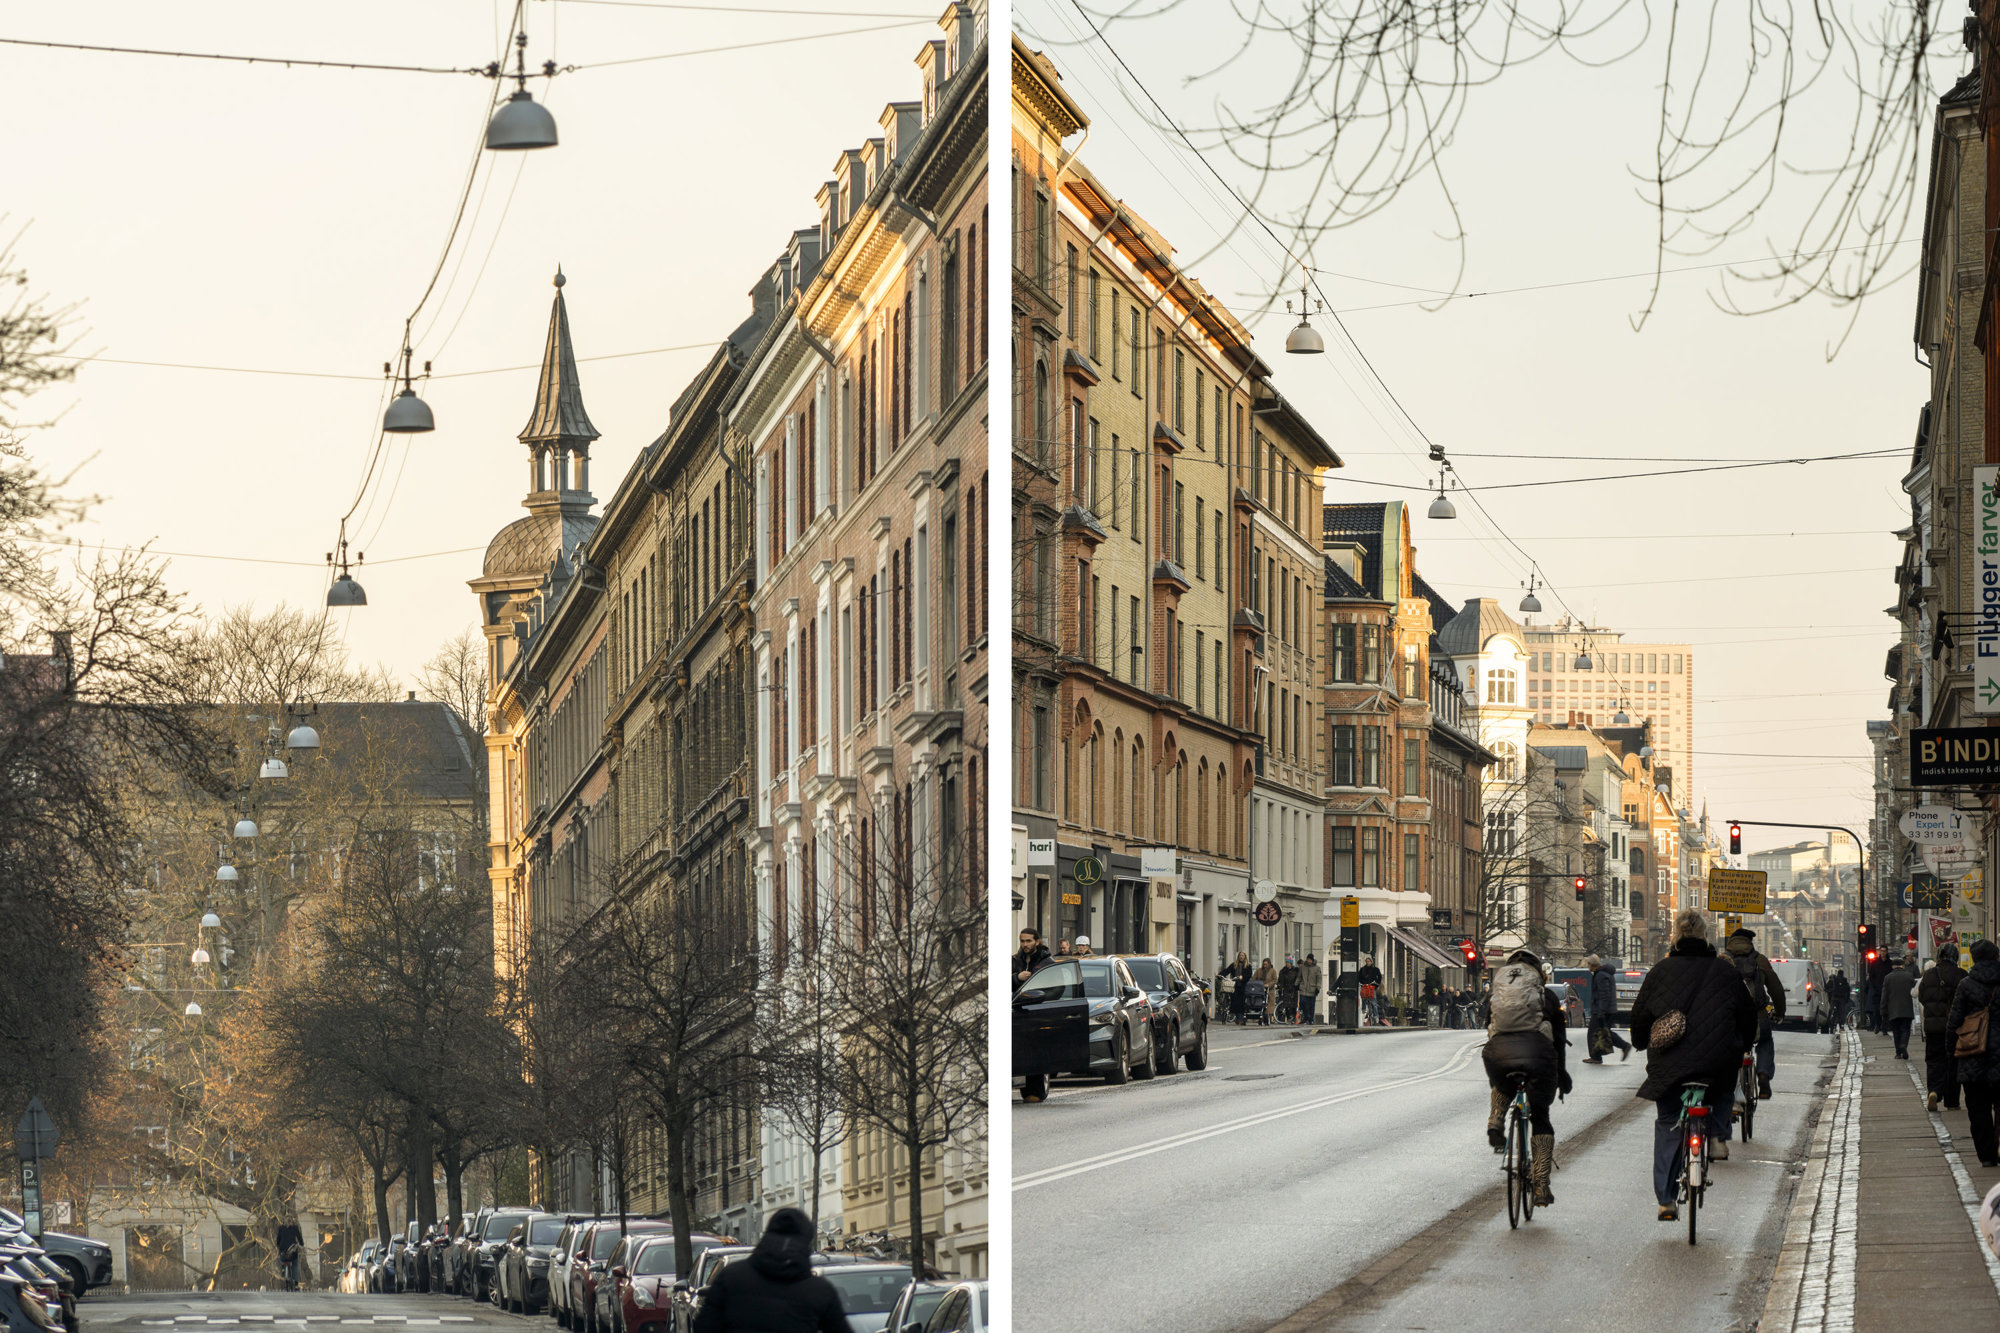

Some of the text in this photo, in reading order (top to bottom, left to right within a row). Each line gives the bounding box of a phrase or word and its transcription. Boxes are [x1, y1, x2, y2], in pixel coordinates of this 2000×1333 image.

[1978, 482, 2000, 657] Flügger farver
[1921, 767, 1945, 775] indisk
[1948, 766, 1984, 775] takeaway
[1987, 765, 1992, 773] &
[1909, 811, 1938, 819] Phone
[1916, 821, 1944, 829] Expert
[1029, 841, 1052, 852] hari
